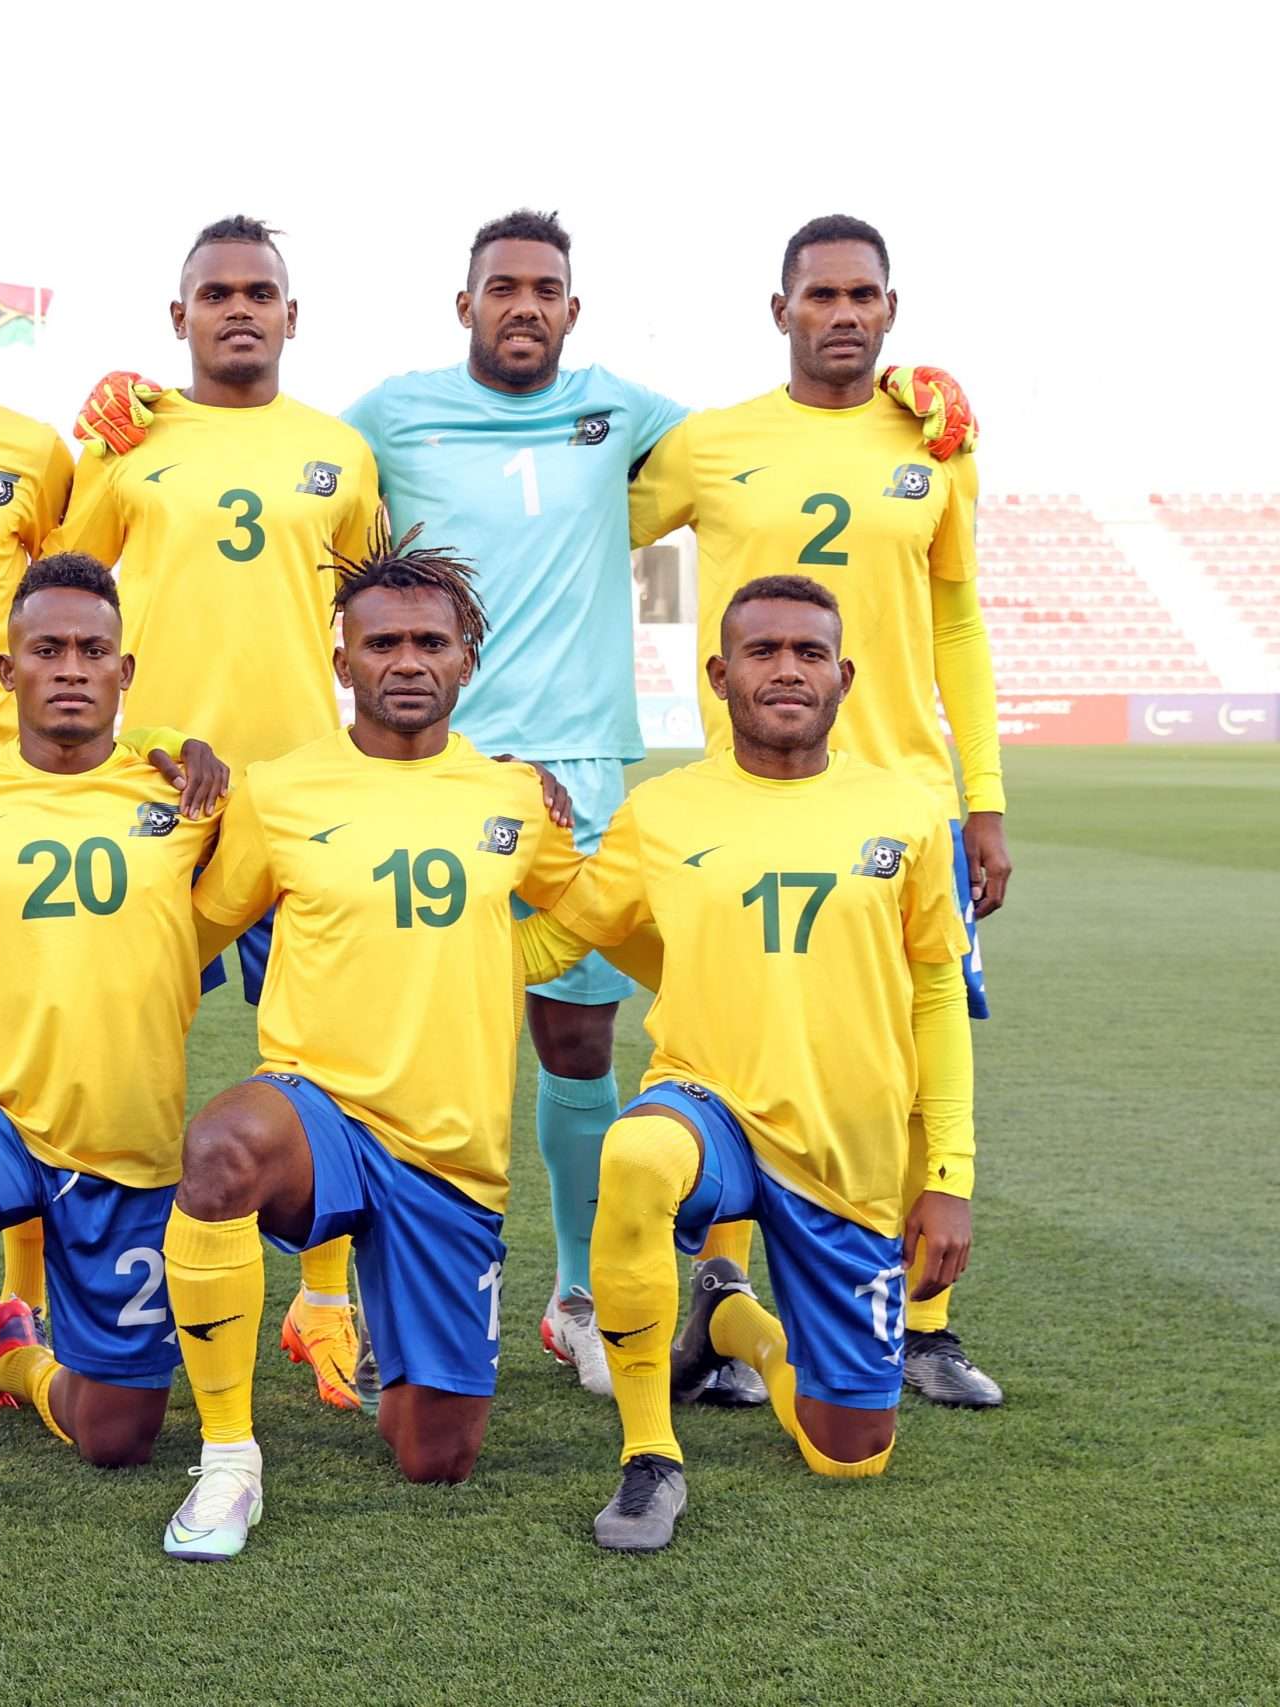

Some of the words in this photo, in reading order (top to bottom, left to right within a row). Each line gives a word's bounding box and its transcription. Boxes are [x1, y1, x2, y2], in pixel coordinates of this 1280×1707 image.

[504, 447, 542, 516] 1
[219, 489, 264, 561] 3
[800, 493, 851, 565] 2
[19, 837, 127, 919] 20
[373, 849, 466, 928] 19
[744, 873, 837, 952] 17
[114, 1247, 167, 1327] 2
[478, 1261, 502, 1340] 1
